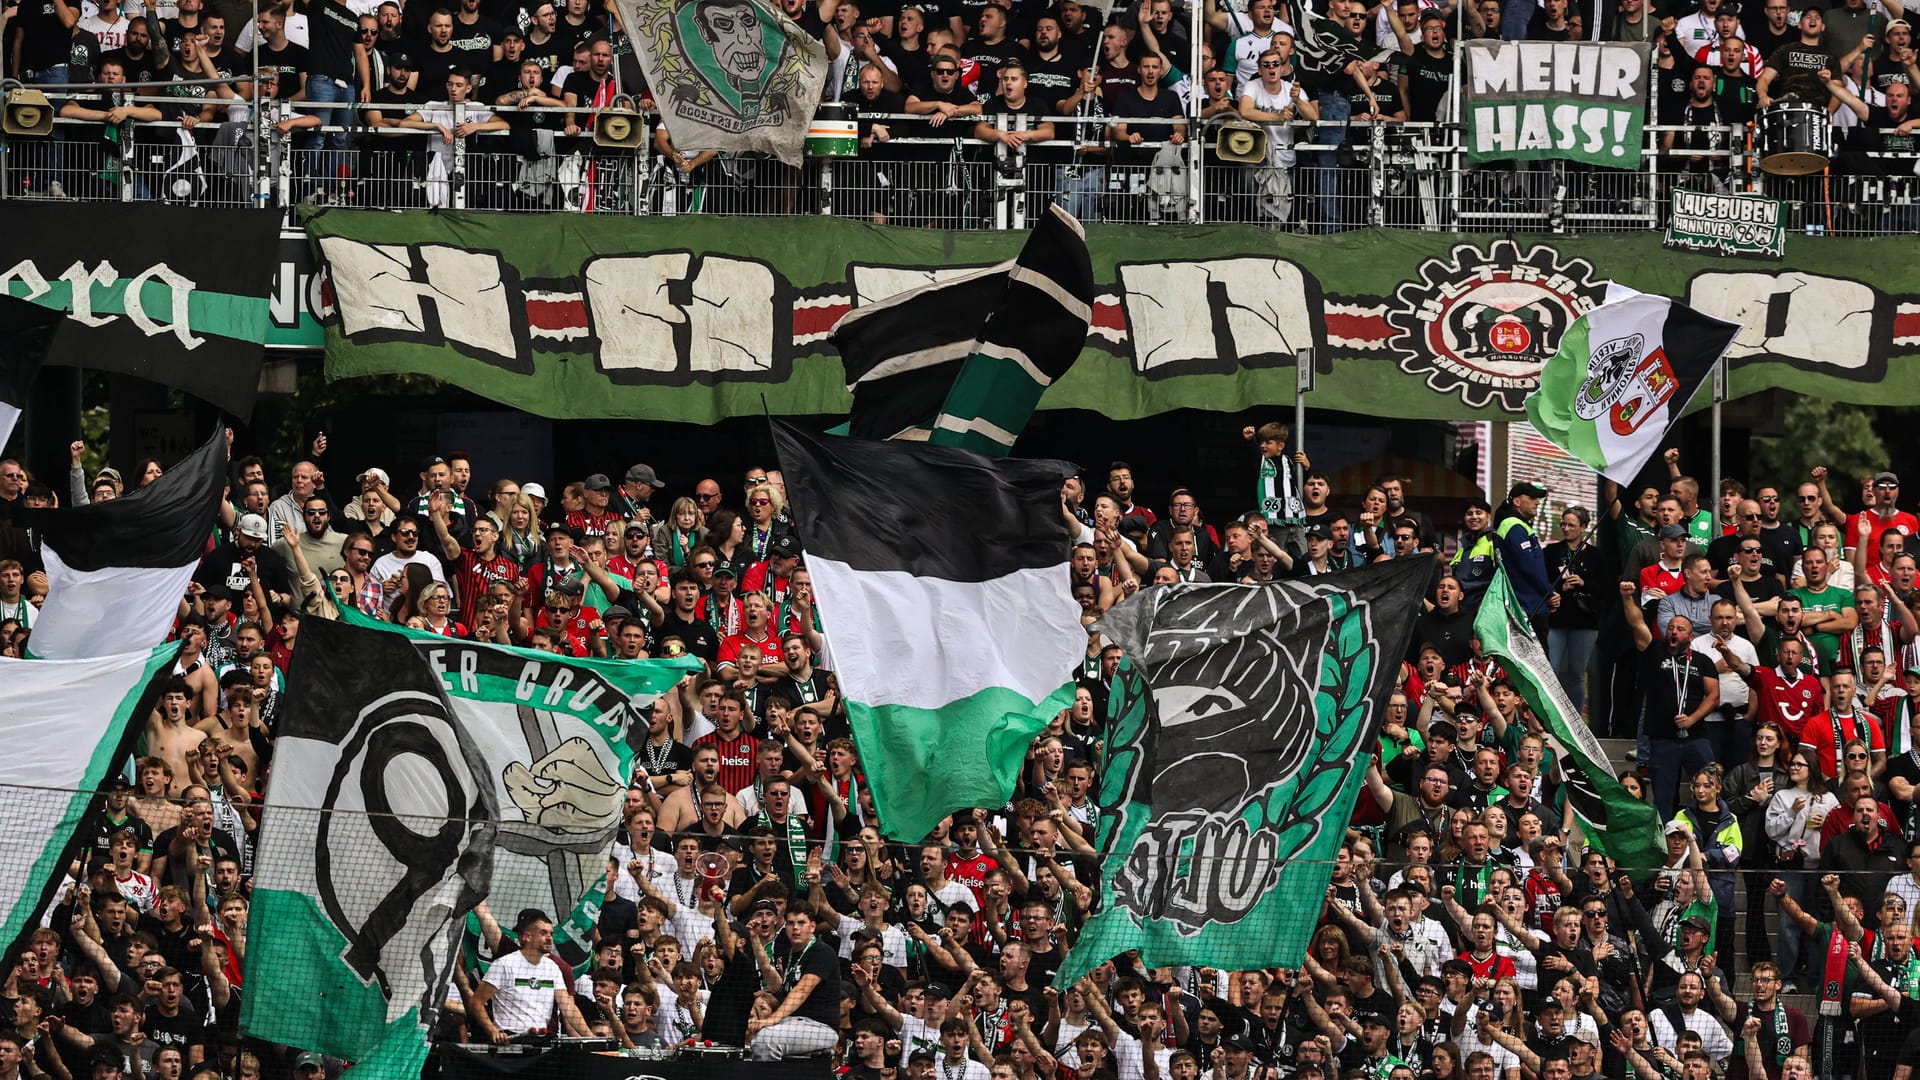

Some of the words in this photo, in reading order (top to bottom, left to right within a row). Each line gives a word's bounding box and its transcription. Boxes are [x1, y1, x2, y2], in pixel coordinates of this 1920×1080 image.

[1789, 52, 1828, 65] WEST
[1469, 43, 1642, 99] MEHR
[1474, 104, 1632, 157] HASS!
[1812, 114, 1821, 150] THOMANN
[1675, 192, 1778, 223] LAUSBUBEN
[1675, 216, 1732, 237] HANNOVER
[1263, 499, 1279, 512] 96
[721, 755, 750, 766] heise
[958, 874, 985, 889] heise
[133, 886, 143, 896] 96
